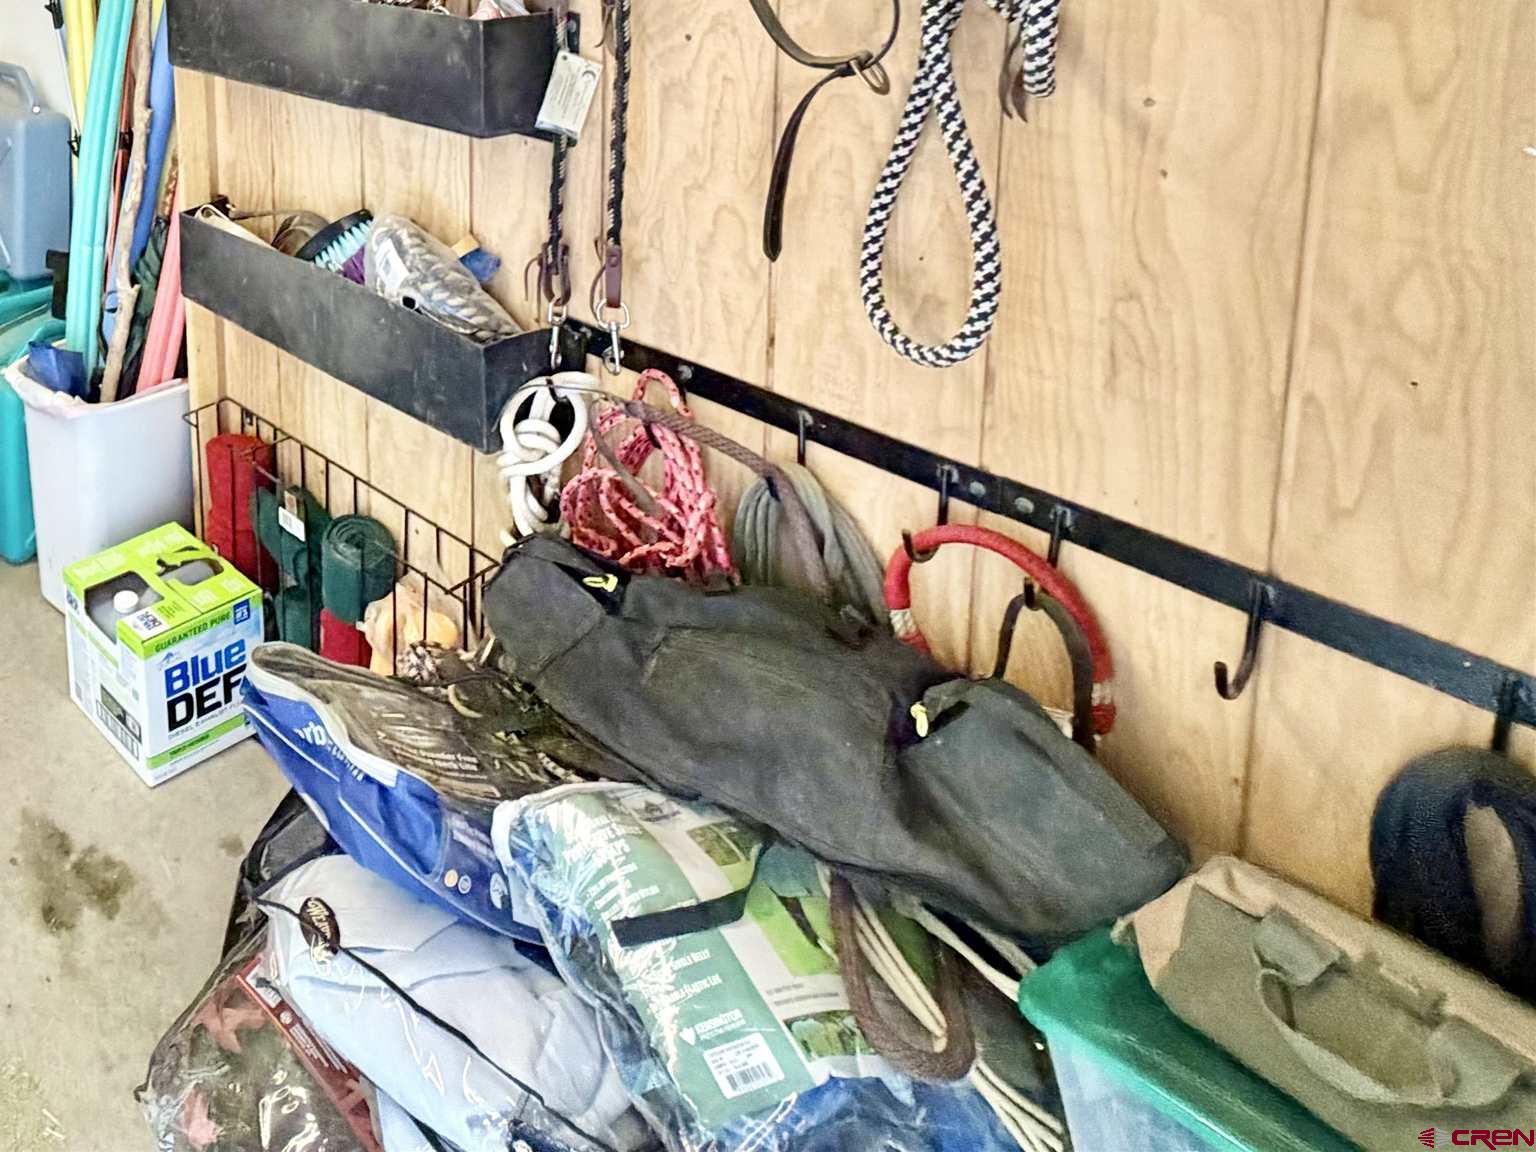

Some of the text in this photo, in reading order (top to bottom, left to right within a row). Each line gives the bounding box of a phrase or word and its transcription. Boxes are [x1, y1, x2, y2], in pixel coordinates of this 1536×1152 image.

[154, 621, 209, 652] GUARANTEED
[209, 611, 232, 630] PURE
[165, 638, 246, 698] Blue
[166, 663, 247, 732] DEF
